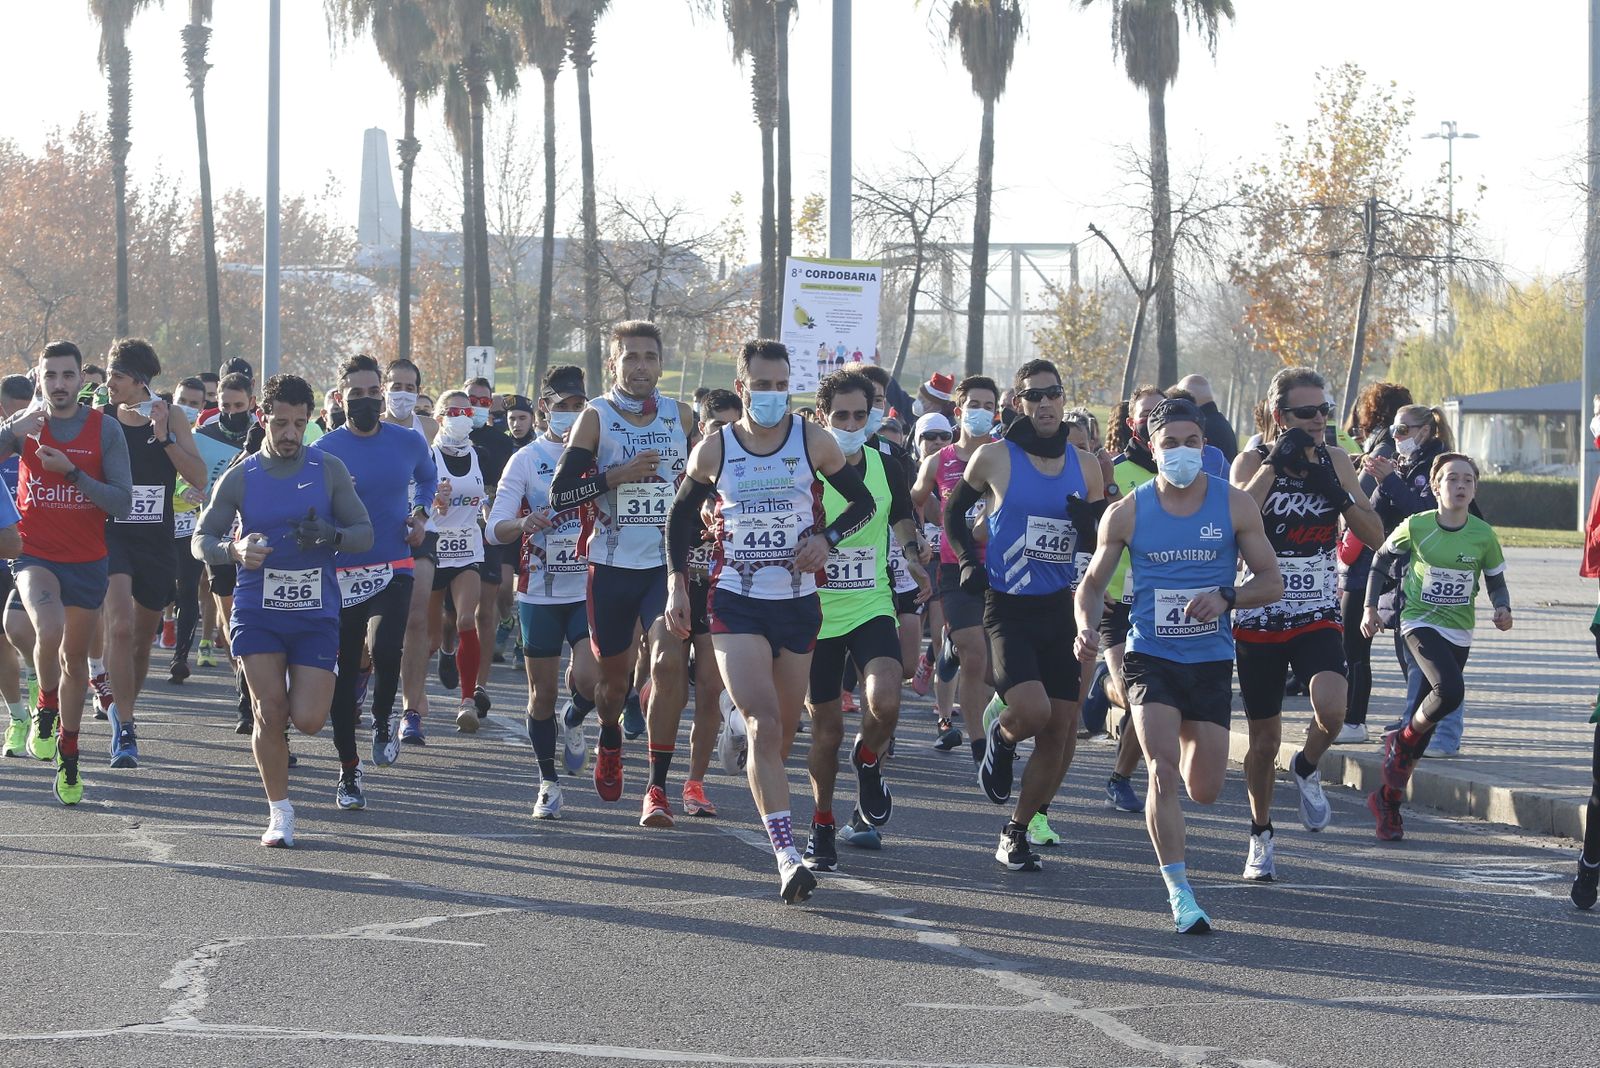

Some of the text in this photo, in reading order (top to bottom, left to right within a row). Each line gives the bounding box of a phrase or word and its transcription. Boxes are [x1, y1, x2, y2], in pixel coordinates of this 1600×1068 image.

[805, 269, 877, 282] CORDOBARIA
[622, 446, 679, 460] Muita
[737, 477, 795, 489] DEPILHOME
[37, 484, 91, 502] califa
[132, 500, 157, 513] 57
[627, 499, 666, 515] 314
[1262, 492, 1335, 518] CORRE
[1199, 522, 1223, 539] als
[1275, 523, 1287, 534] O
[1286, 524, 1335, 544] MUERE
[439, 539, 467, 551] 368
[743, 530, 786, 549] 443
[1035, 534, 1070, 552] 446
[556, 550, 579, 563] 44
[735, 548, 794, 560] LA CORDOBARIA
[1147, 549, 1217, 563] TROTASIERRA
[826, 562, 863, 580] 311
[827, 580, 874, 588] CORDOBARIA
[1431, 581, 1465, 596] 382
[273, 584, 312, 600] 456
[1282, 591, 1321, 599] ORDOBARIA
[274, 600, 319, 608] CORDOBAR
[1430, 596, 1468, 604] CORDOBARIA
[1165, 607, 1191, 625] 47
[1157, 623, 1216, 635] LA CORDOBARIA
